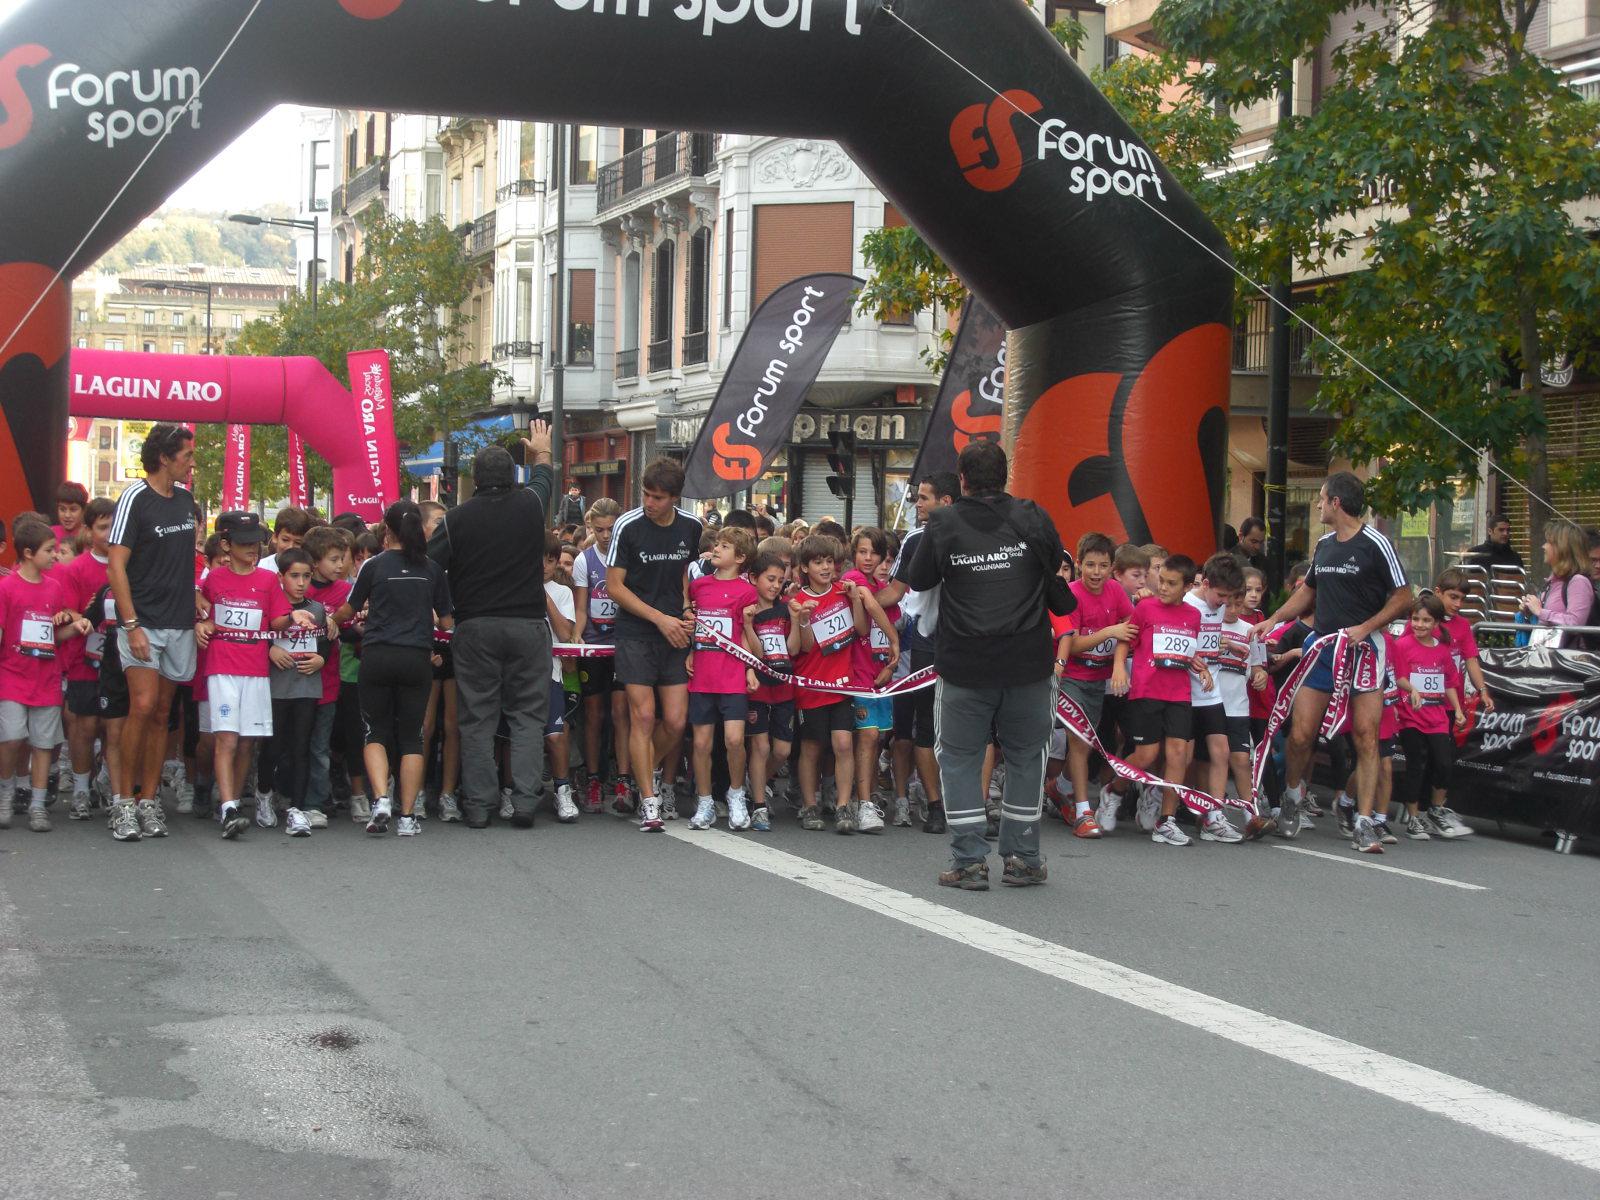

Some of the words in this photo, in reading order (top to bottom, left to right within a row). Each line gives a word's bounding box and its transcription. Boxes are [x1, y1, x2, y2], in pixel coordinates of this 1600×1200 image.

[87, 99, 202, 148] sport
[1068, 166, 1167, 201] sport
[779, 285, 825, 354] sport
[74, 374, 161, 399] LAGUN
[167, 380, 222, 402] ARO
[951, 554, 985, 566] LAGUN
[986, 552, 1009, 561] ARO
[971, 561, 1011, 571] VOLUNTARIO
[223, 609, 249, 627] 231
[823, 613, 848, 635] 321
[1164, 636, 1190, 653] 289
[725, 645, 765, 670] LAGUN
[1423, 676, 1439, 691] 85
